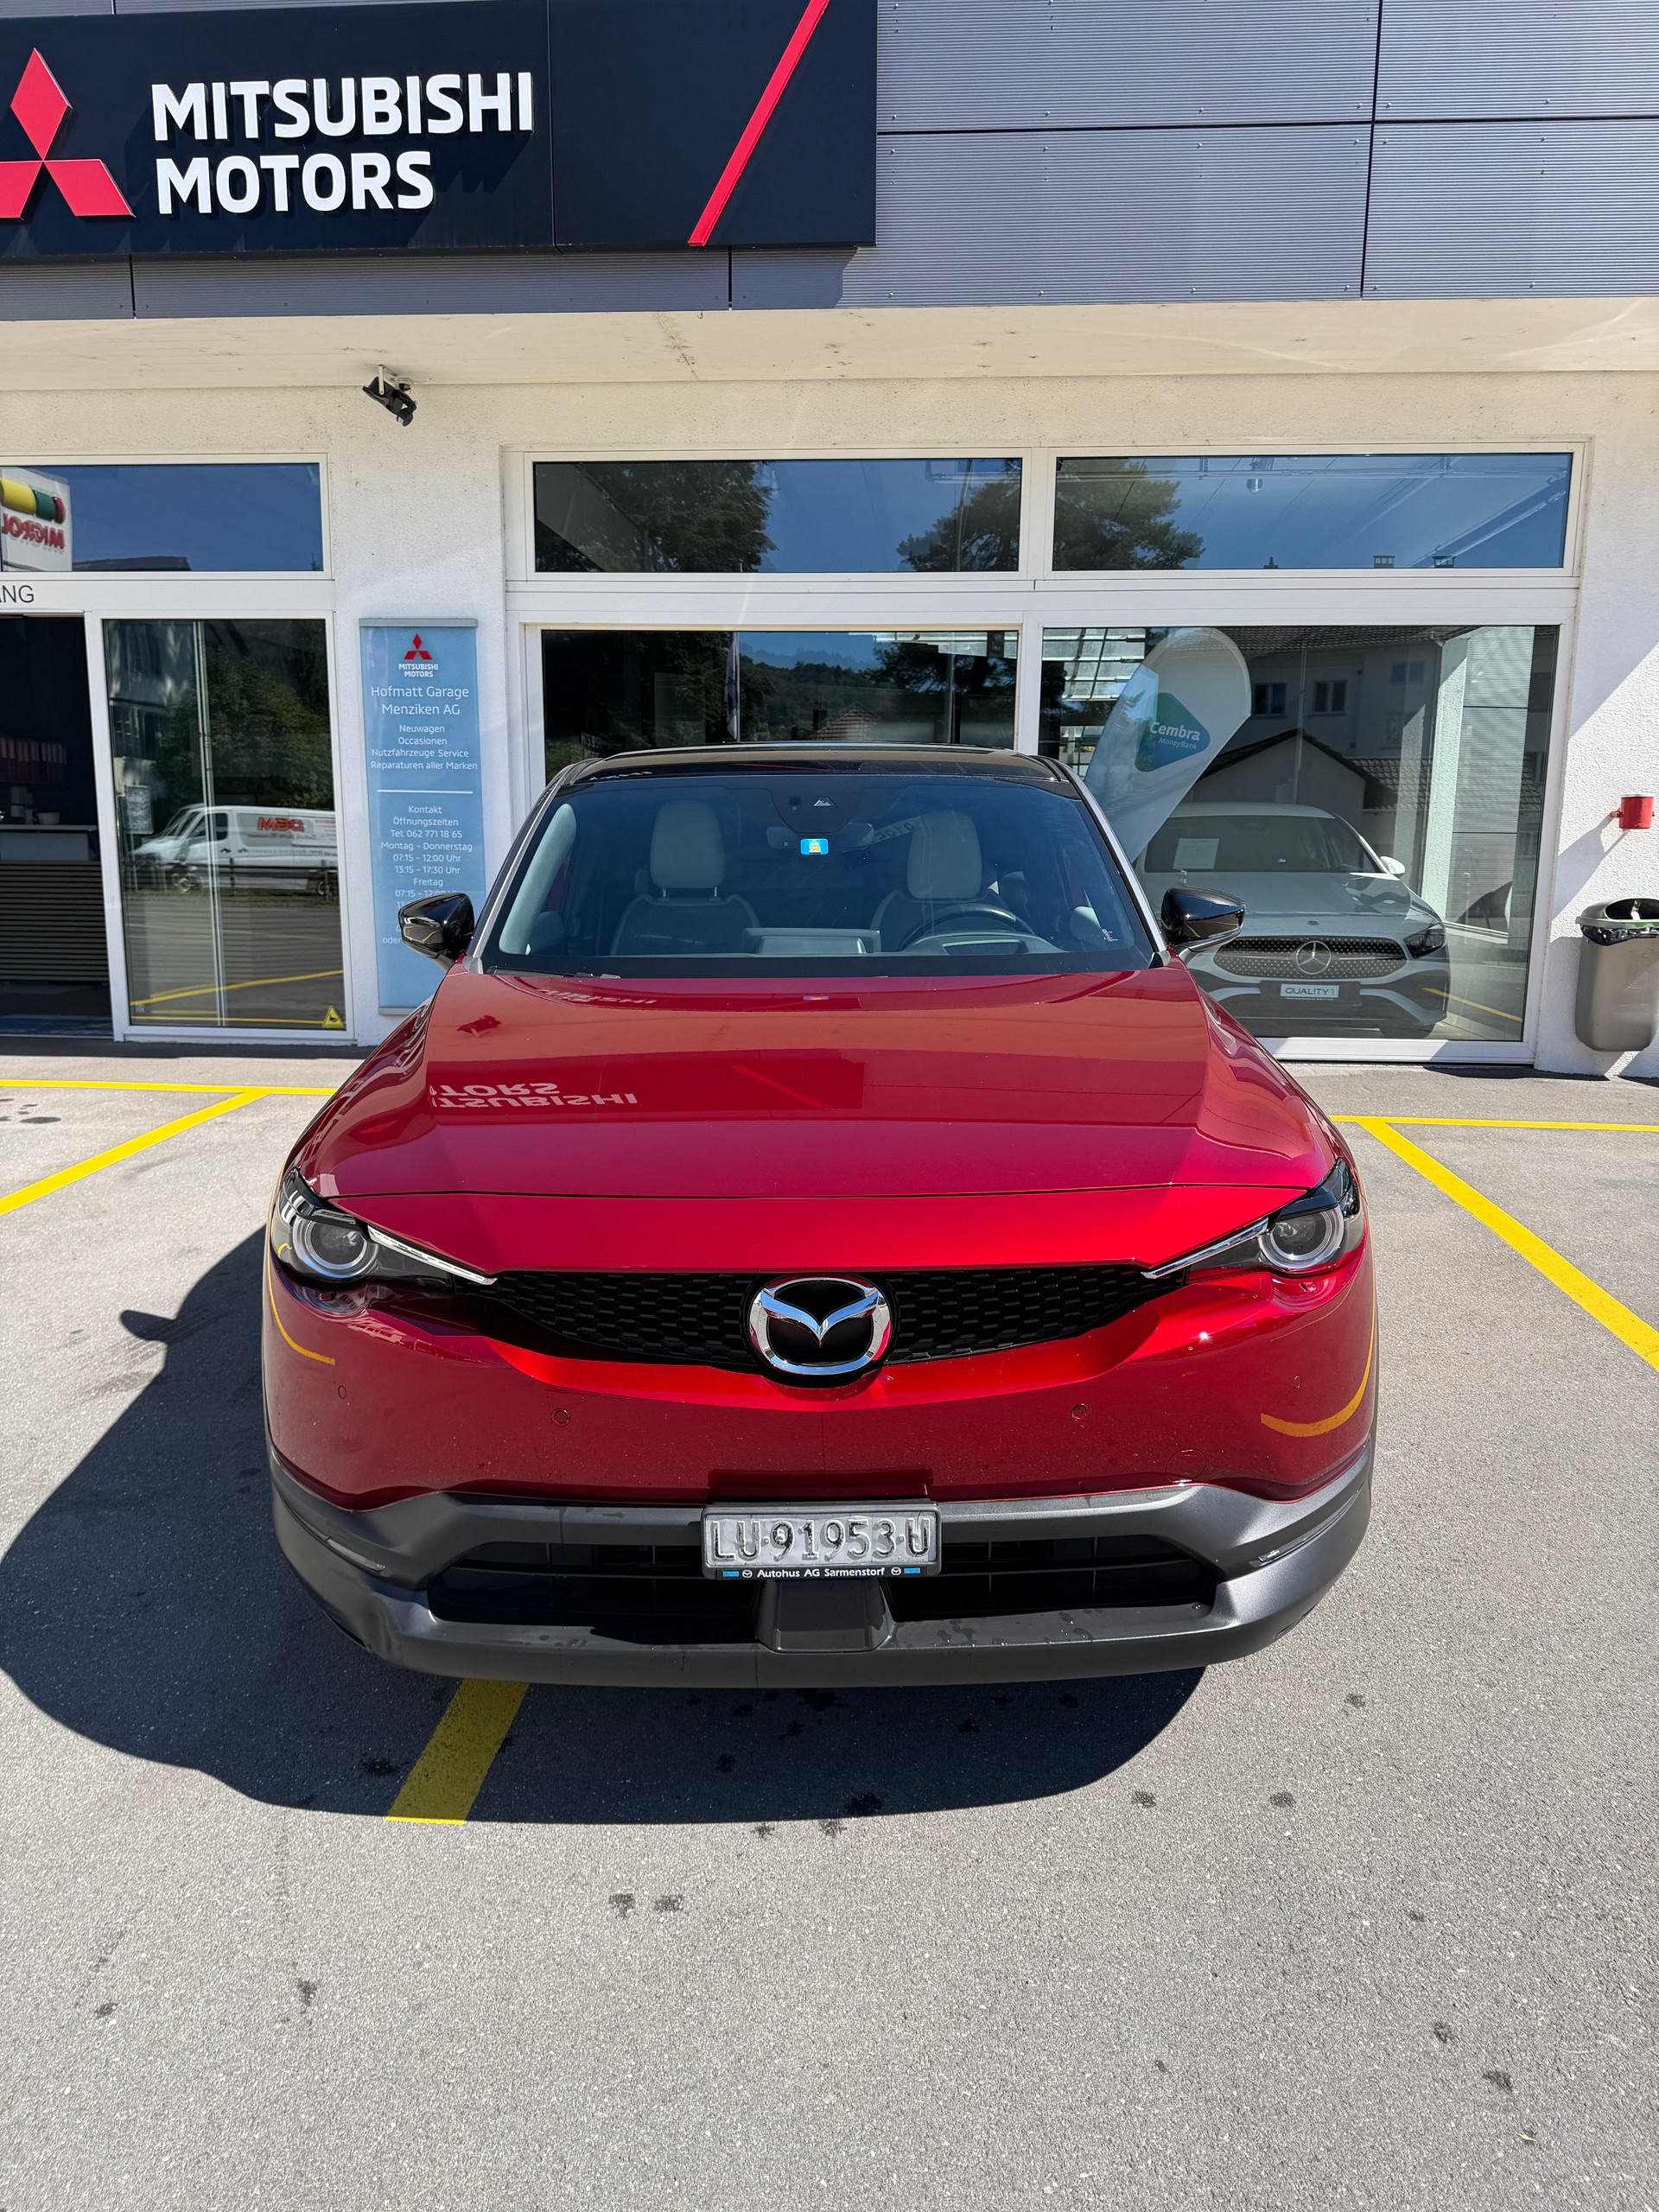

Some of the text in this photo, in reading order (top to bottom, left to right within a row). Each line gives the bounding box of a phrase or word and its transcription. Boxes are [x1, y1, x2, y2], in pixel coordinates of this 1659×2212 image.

[151, 72, 534, 141] MITSUBISHI
[156, 150, 435, 214] MOTORS
[371, 686, 469, 700] Hofmatt Garage
[382, 704, 460, 715] Menziken AG
[399, 725, 445, 734] Neuwagen
[1149, 721, 1200, 741] Cembra
[1159, 737, 1198, 750] MoneyBank
[372, 749, 435, 759] Nutzfahrzeuge
[371, 761, 423, 771] Reparaturen
[393, 816, 459, 827] Öffnungszeiten
[381, 842, 414, 851] Montag
[423, 842, 473, 853] Donnerstag
[423, 866, 443, 874] 17:30
[413, 878, 443, 887] Freitag
[1285, 987, 1329, 995] QUALITY
[757, 1569, 800, 1578] Autohus
[824, 1567, 885, 1577] Sarmenstorf
